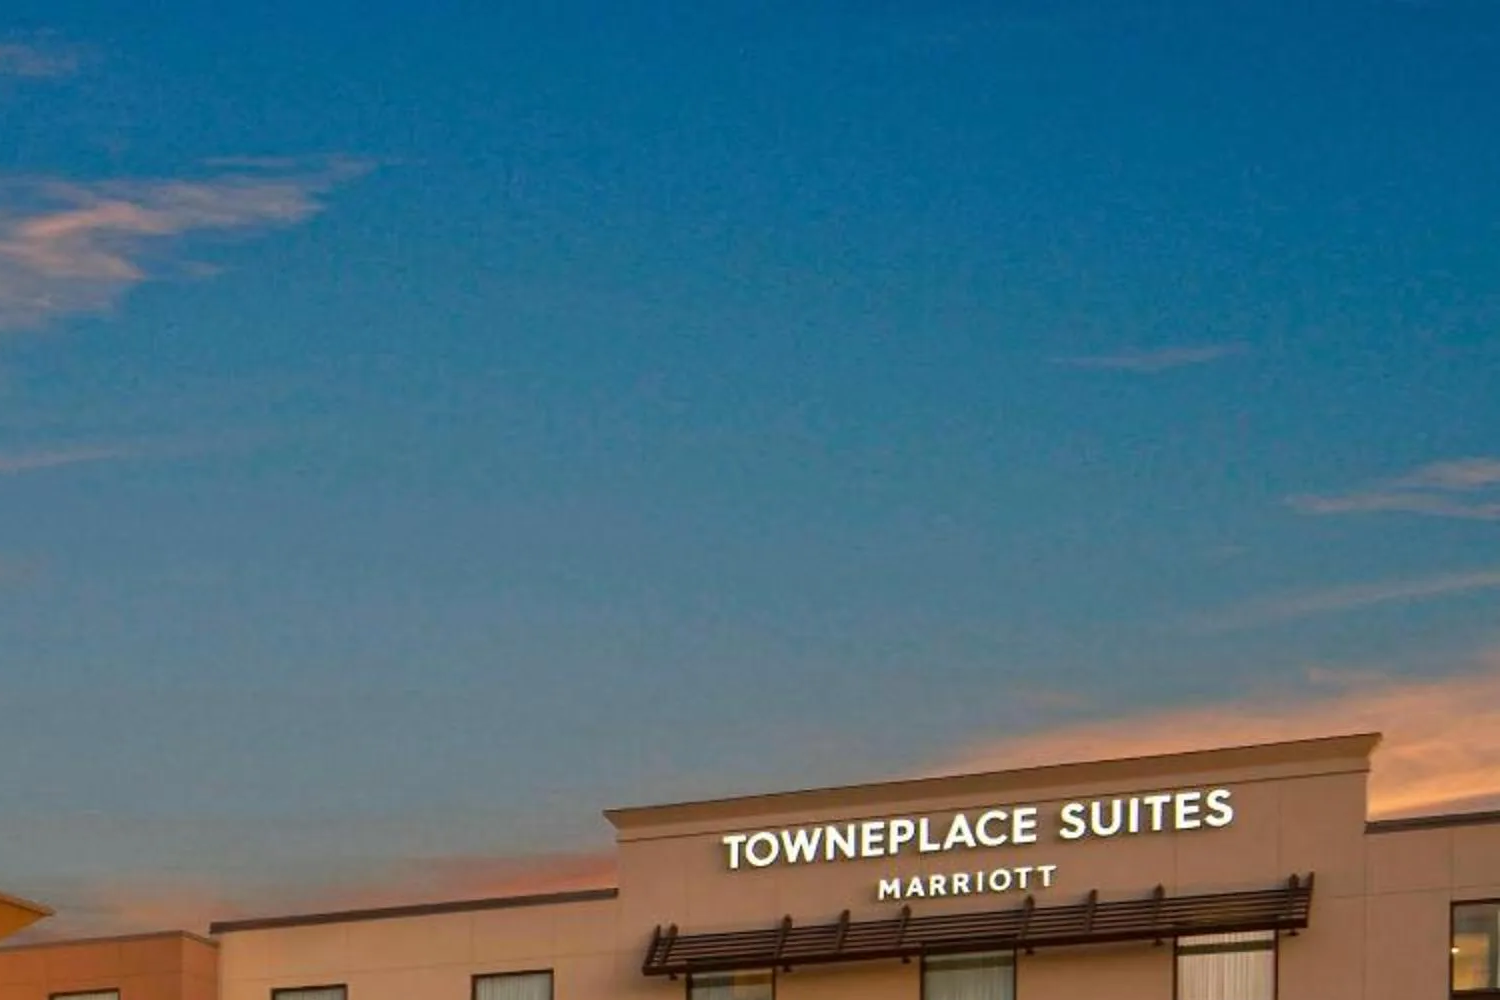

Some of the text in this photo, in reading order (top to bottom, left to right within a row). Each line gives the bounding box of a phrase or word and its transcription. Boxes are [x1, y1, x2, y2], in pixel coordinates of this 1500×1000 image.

[722, 788, 1235, 869] TOWNEPLACE SUITES
[877, 865, 1058, 900] MARRIOTT
